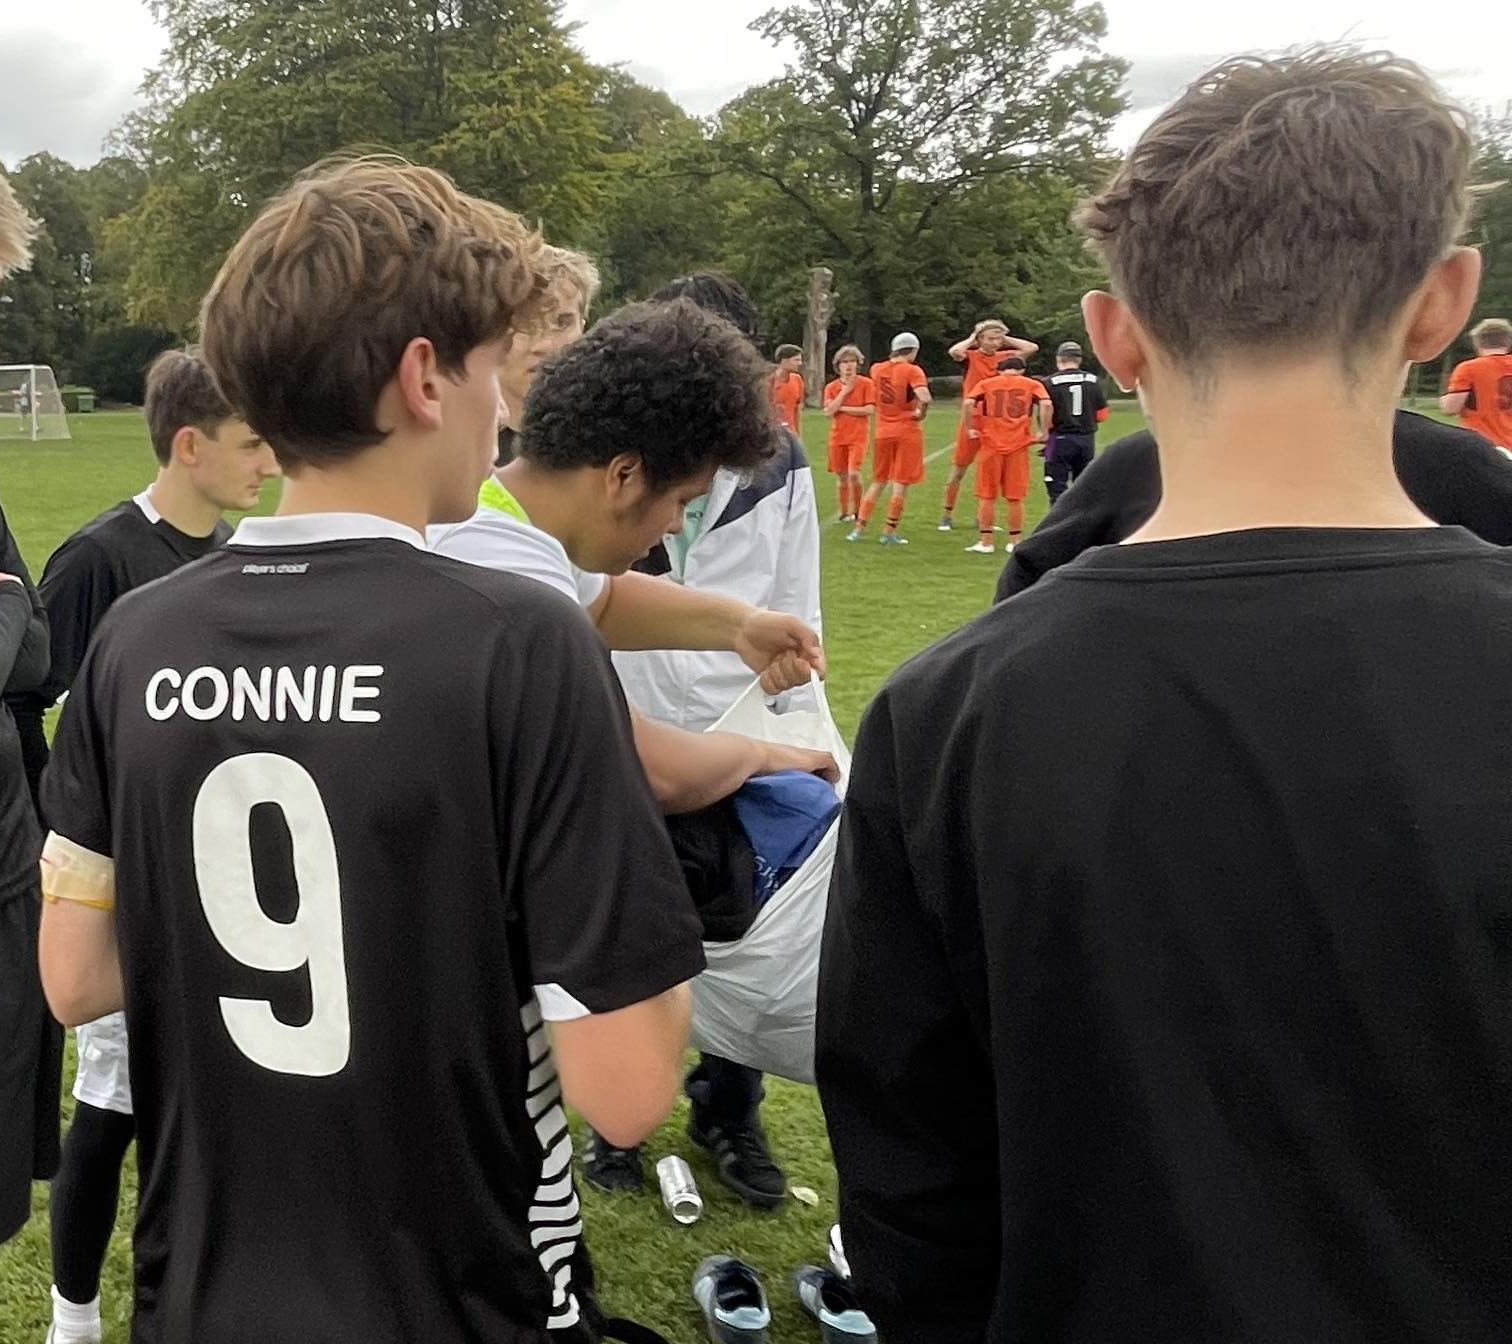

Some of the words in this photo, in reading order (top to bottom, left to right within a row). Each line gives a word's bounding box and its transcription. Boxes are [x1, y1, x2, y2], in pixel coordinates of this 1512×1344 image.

[992, 388, 1028, 418] 15
[1069, 384, 1083, 415] 1
[145, 665, 384, 723] CONNIE
[192, 752, 351, 1077] 9
